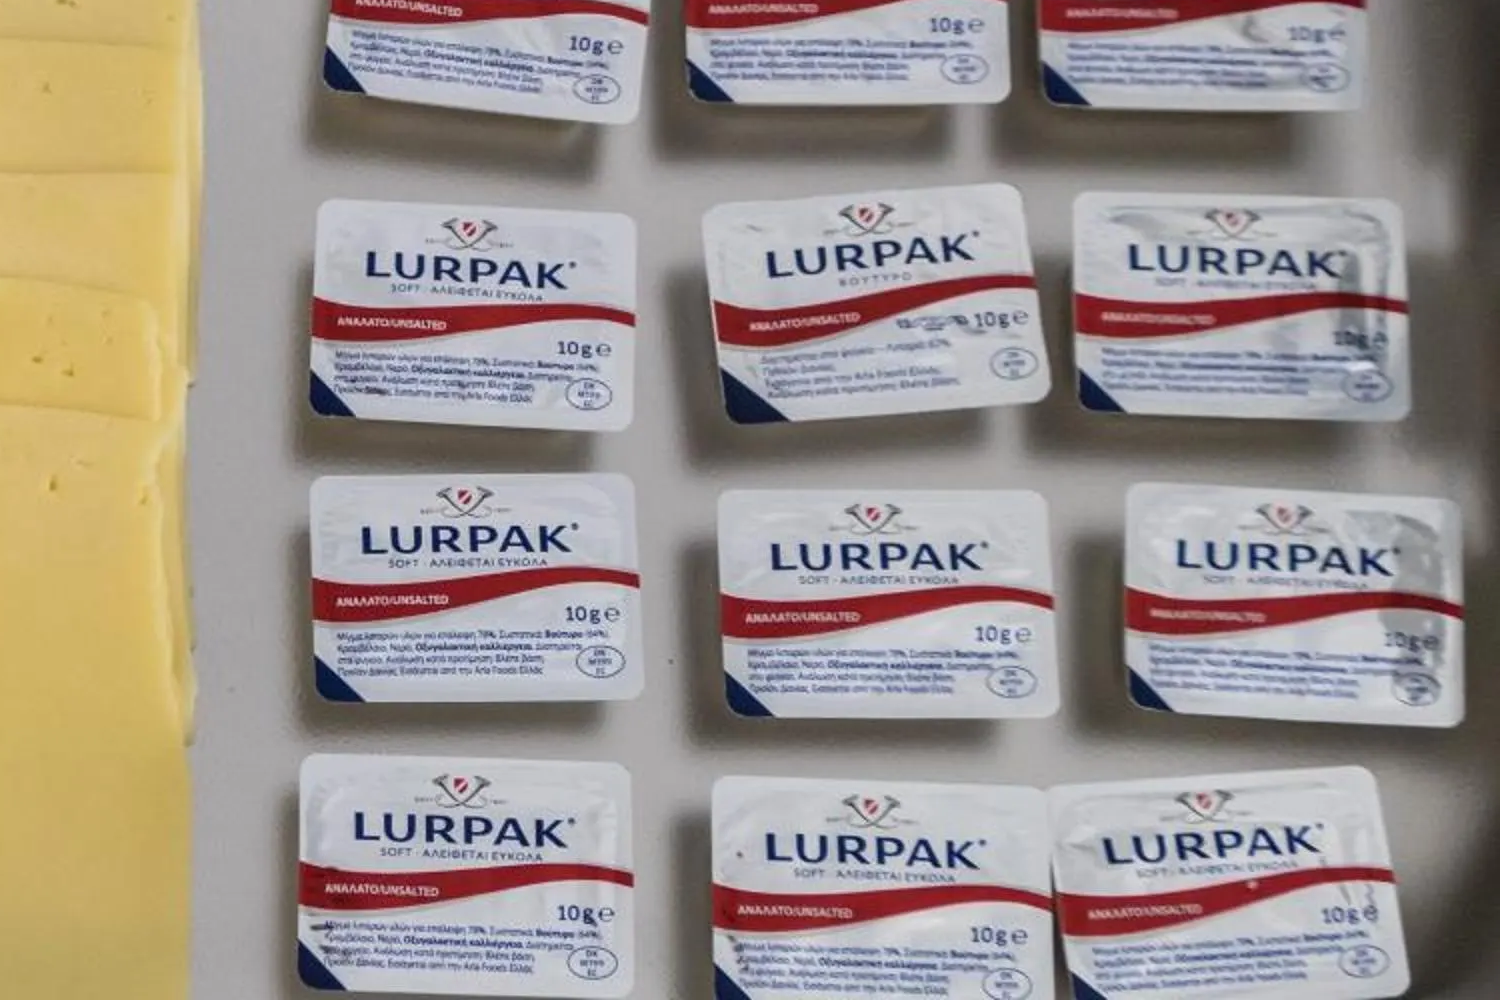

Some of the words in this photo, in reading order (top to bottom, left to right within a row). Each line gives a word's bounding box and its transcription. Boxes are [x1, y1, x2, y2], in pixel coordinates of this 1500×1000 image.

[365, 251, 569, 290] LURPAK
[767, 232, 975, 279] LURPAK
[1127, 243, 1342, 279] LURPAK
[361, 525, 573, 555] LURPAK
[770, 541, 984, 572] LURPAK
[1176, 539, 1394, 577] LURPAK
[353, 811, 568, 849] LURPAK
[1102, 824, 1321, 866] LURPAK
[765, 832, 981, 871] LURPAK
